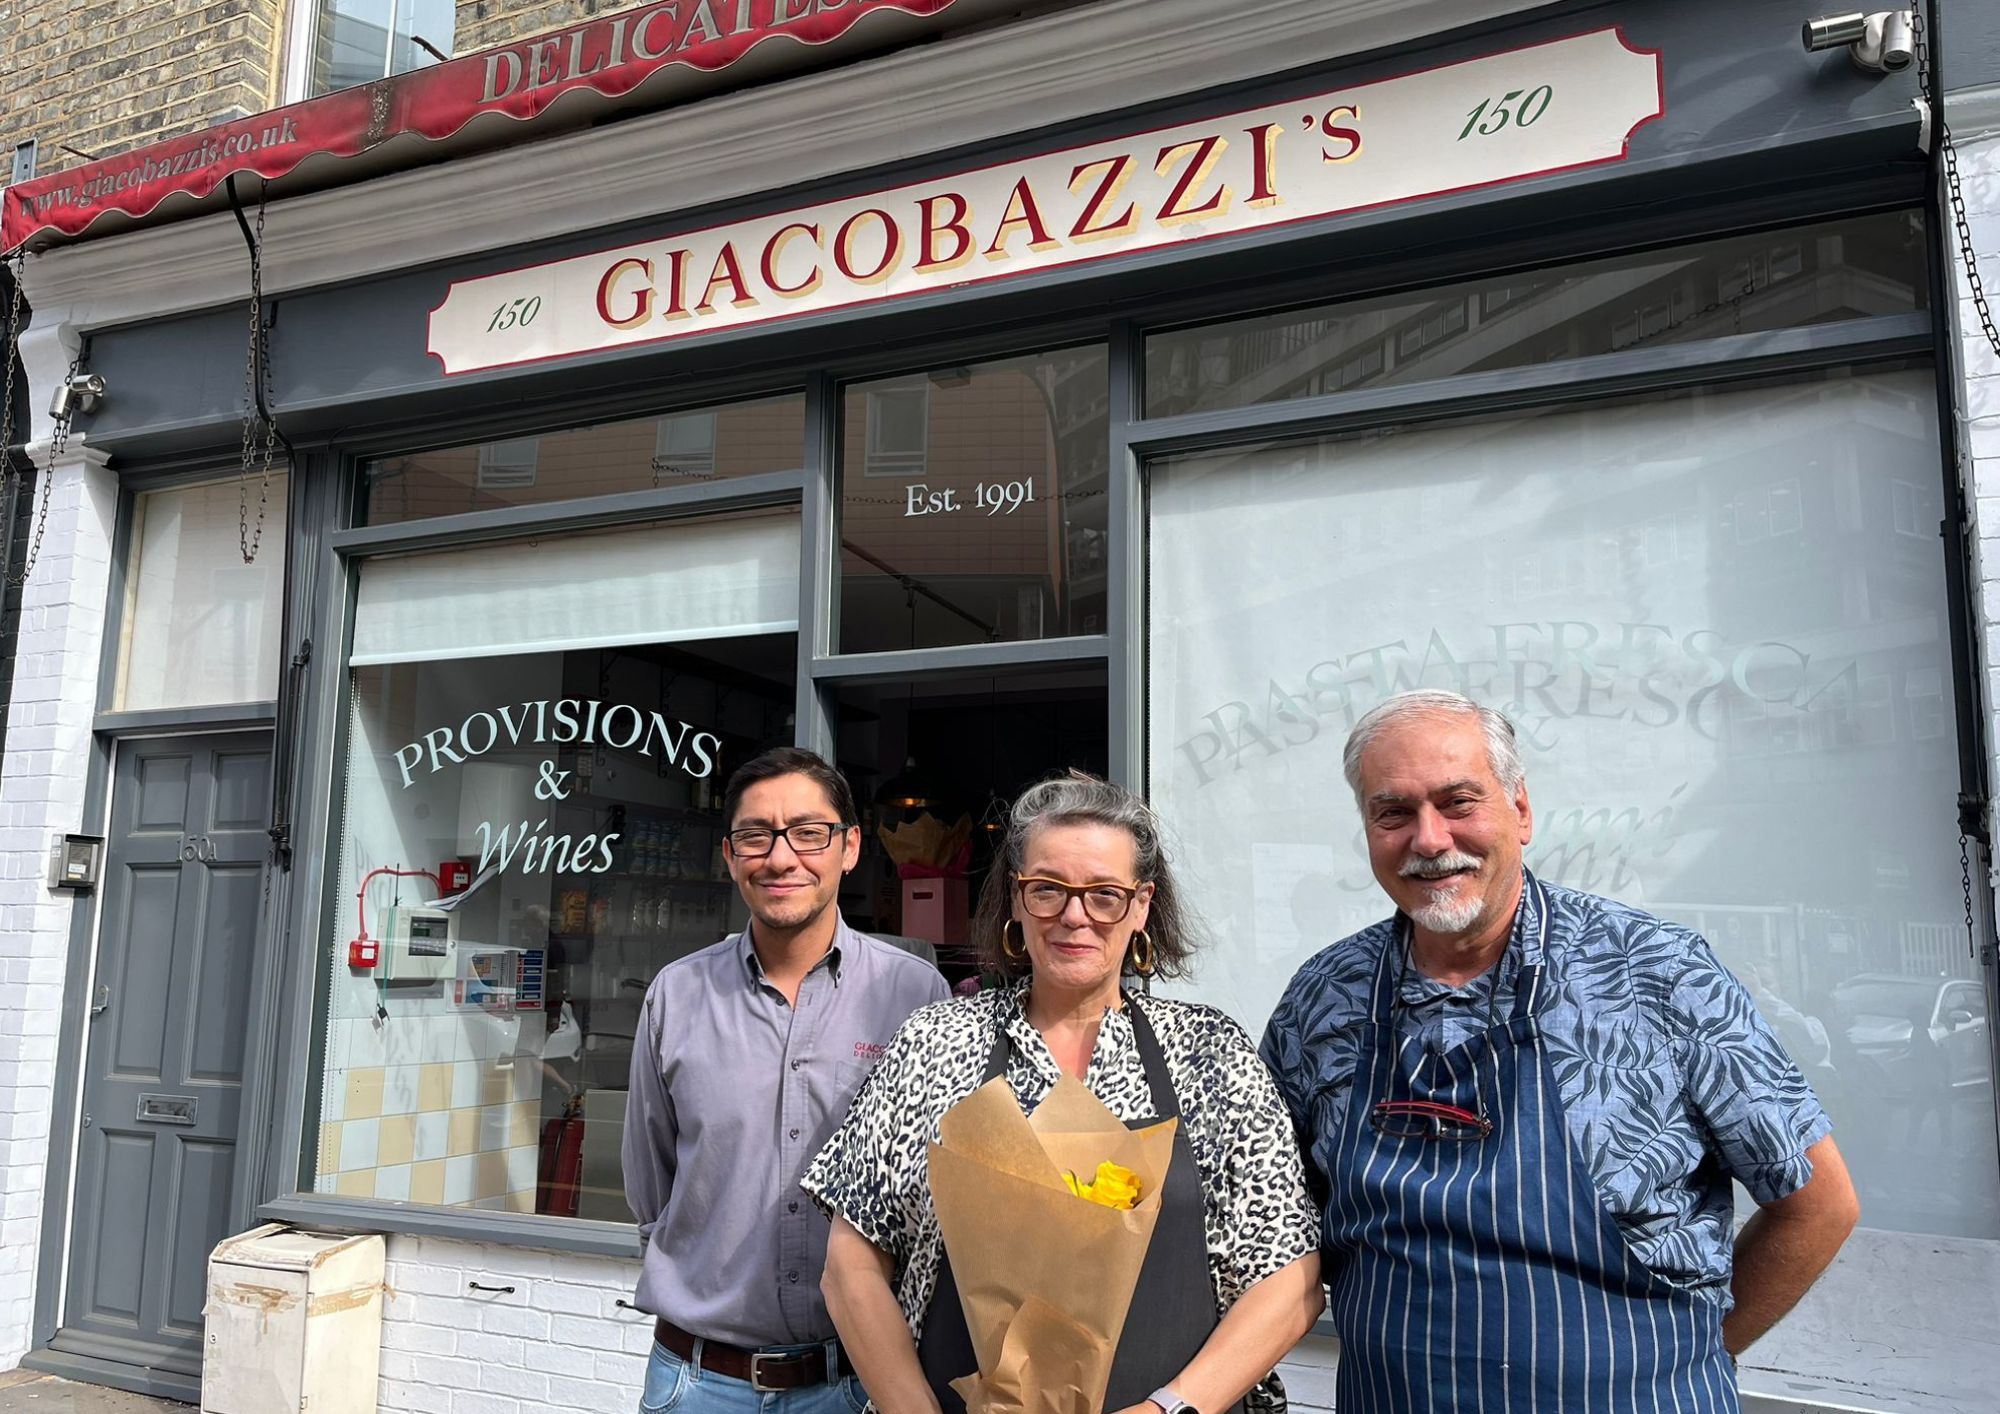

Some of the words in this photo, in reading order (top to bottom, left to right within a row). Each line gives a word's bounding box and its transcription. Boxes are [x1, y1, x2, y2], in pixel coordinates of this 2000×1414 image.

[479, 0, 860, 104] DELICATE
[1457, 84, 1553, 142] 150
[21, 116, 299, 217] www.giacobazzis.co.uk
[596, 105, 1364, 330] GIACOBAZZI'S
[486, 296, 541, 333] 150
[903, 483, 962, 517] Est.
[974, 476, 1036, 517] 1991
[393, 699, 723, 790] PROVISIONS
[534, 759, 571, 800] &
[474, 818, 620, 876] Wines
